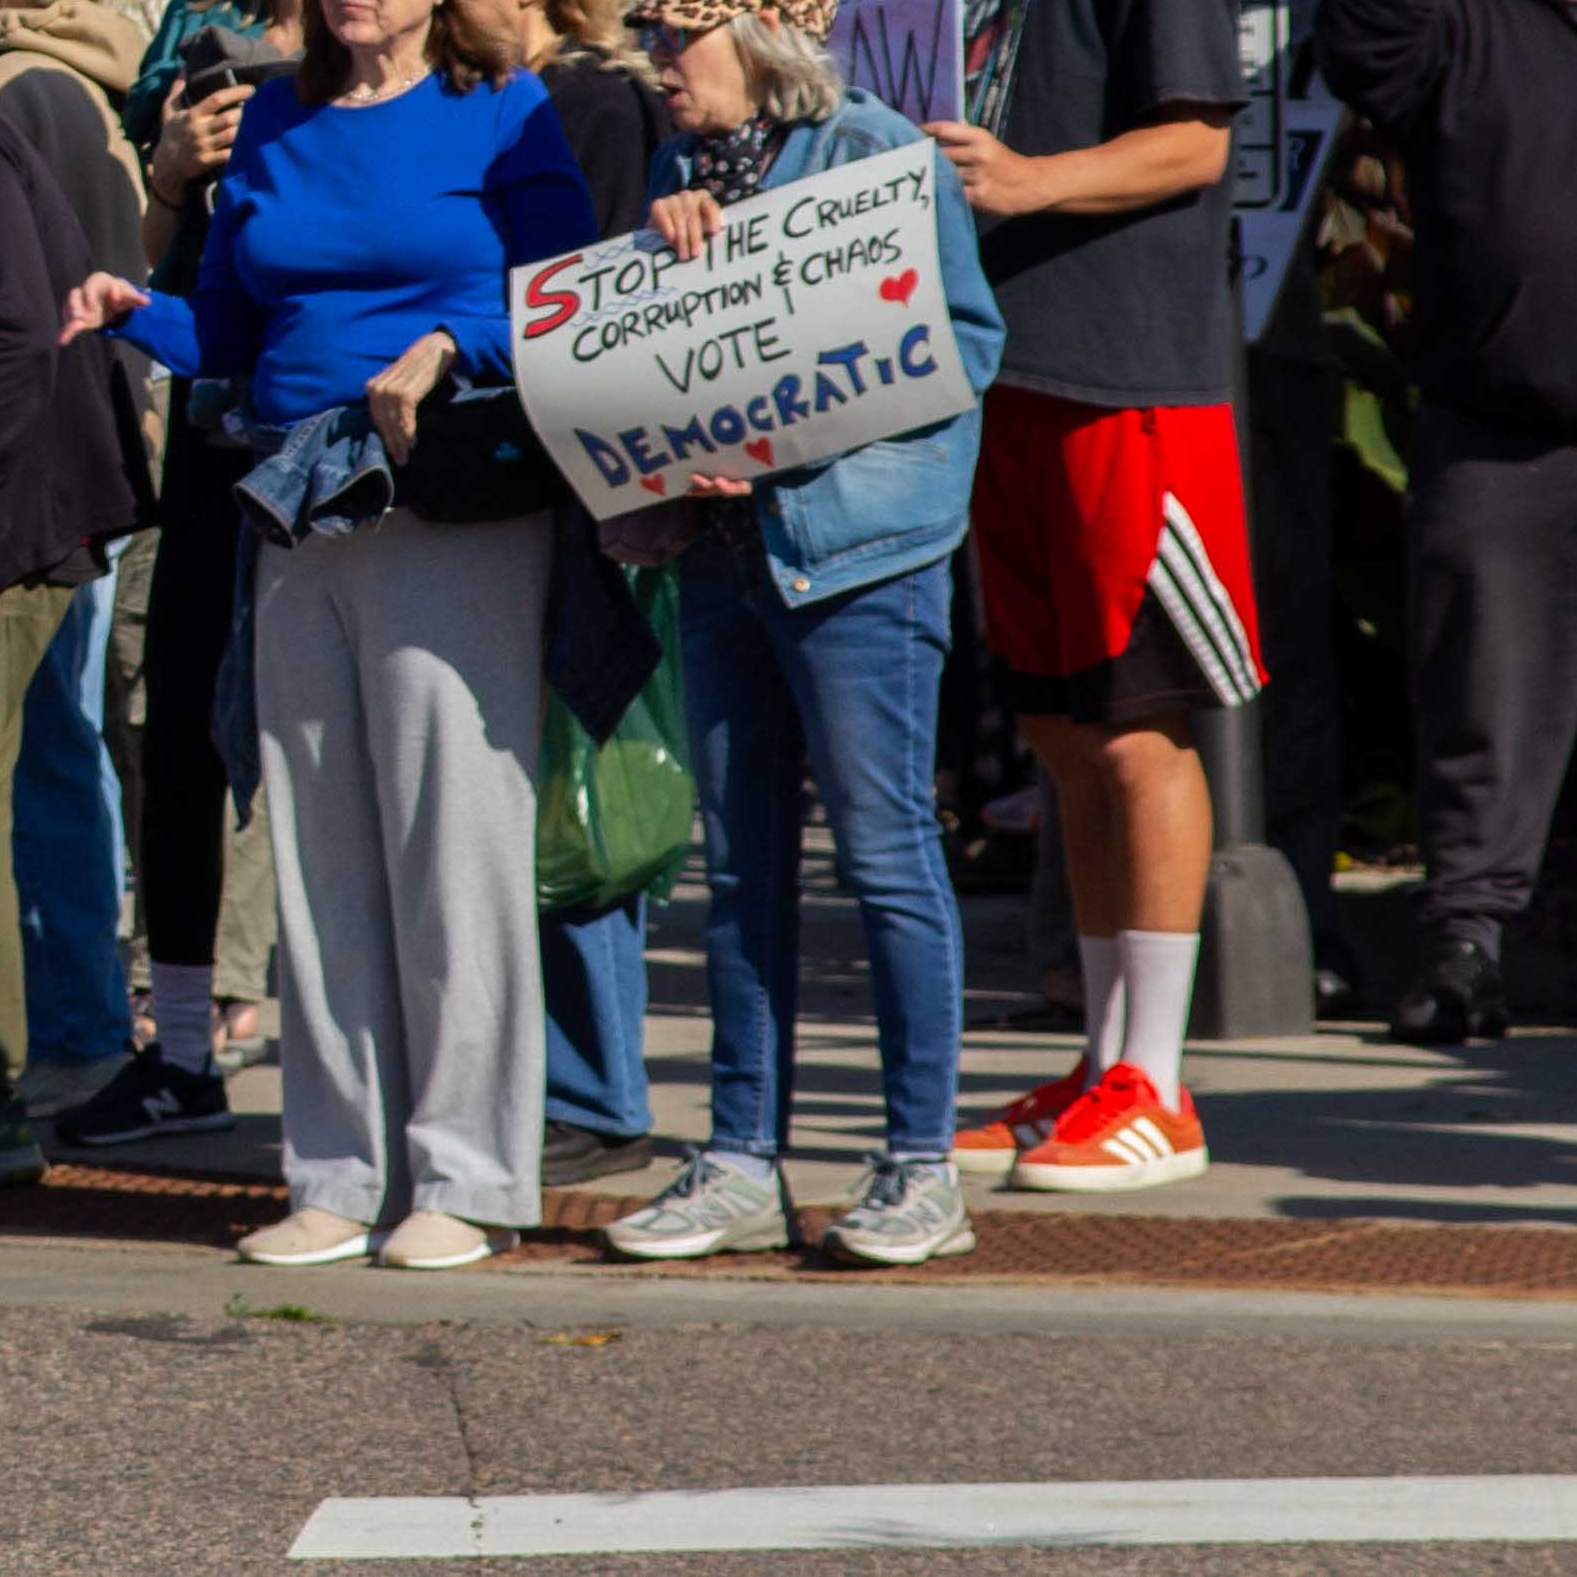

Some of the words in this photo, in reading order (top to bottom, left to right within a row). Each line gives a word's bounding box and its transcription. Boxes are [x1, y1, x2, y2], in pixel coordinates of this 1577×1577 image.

[522, 254, 680, 340] STOP
[702, 213, 770, 271] THE
[571, 271, 763, 363] CORRUPTION
[800, 229, 902, 286] CHAOS
[574, 324, 938, 489] DEMOCRATIC
[655, 318, 793, 394] VOTE
